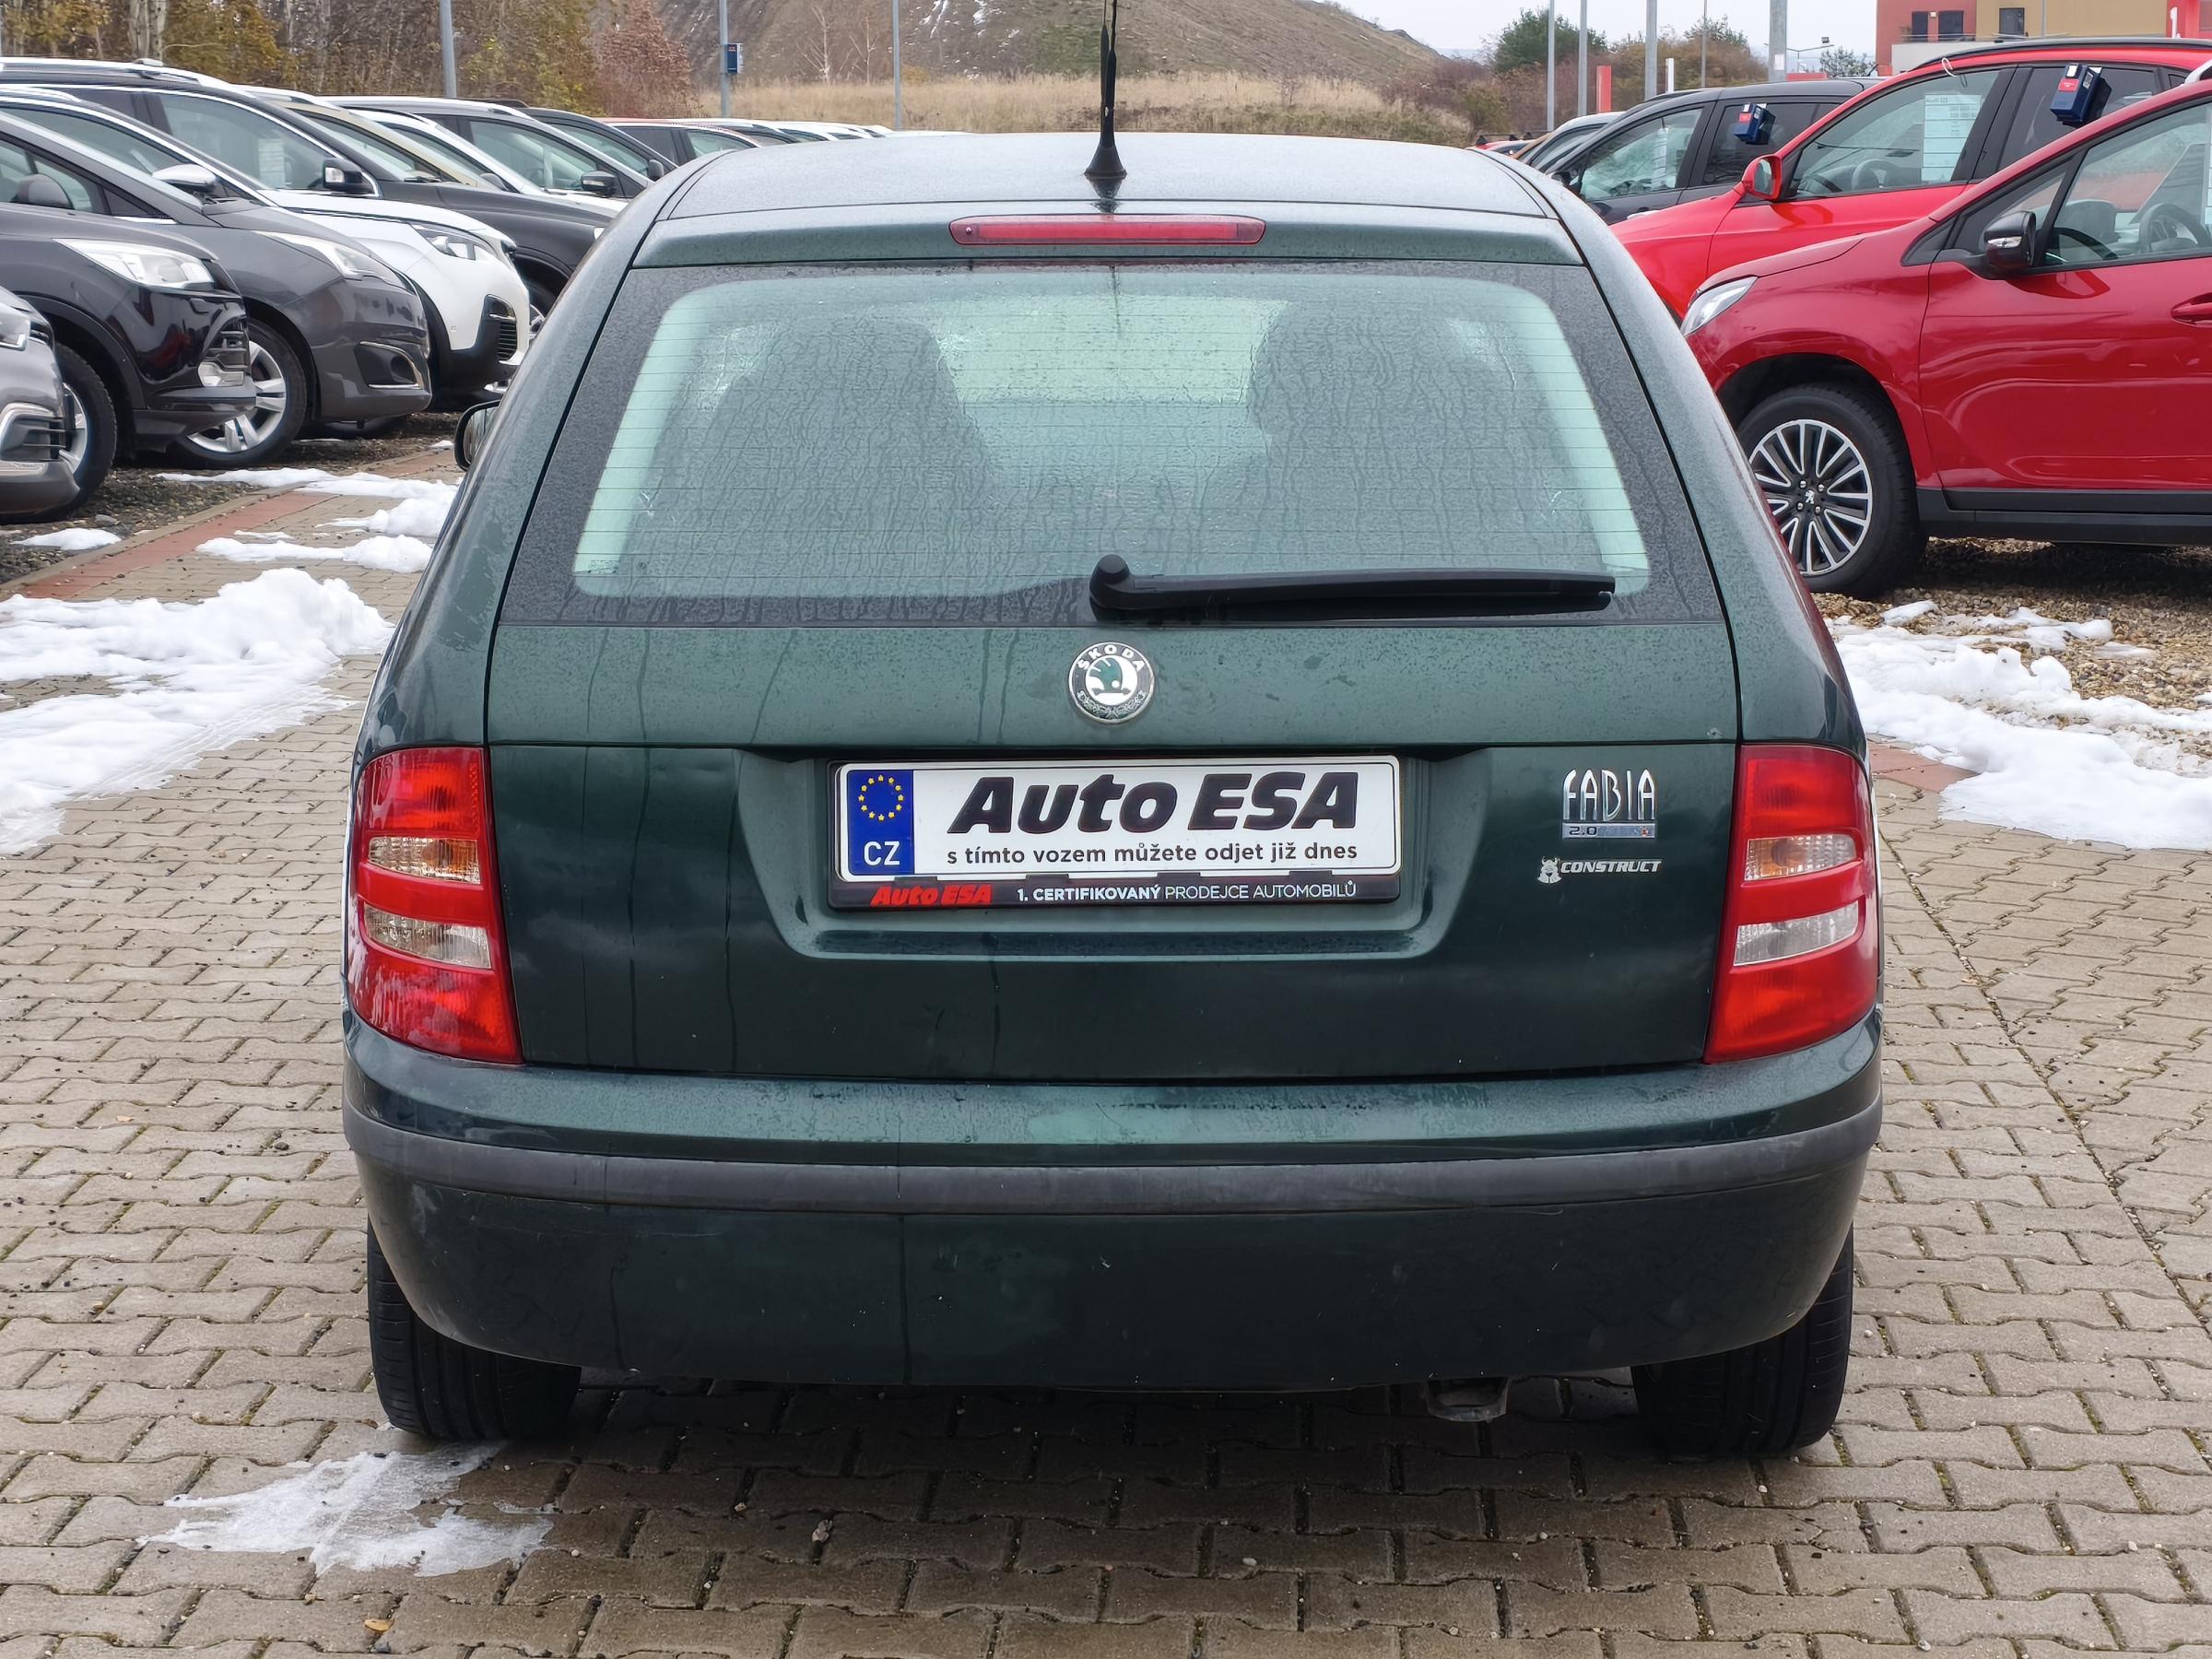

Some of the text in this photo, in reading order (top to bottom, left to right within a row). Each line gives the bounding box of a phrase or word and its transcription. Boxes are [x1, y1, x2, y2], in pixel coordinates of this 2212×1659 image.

[947, 771, 1359, 834] Auto ESA
[1562, 769, 1655, 822] FABIA
[1569, 826, 1598, 836] 2.0
[863, 841, 900, 866] CZ
[947, 841, 1358, 865] s tímto vozem můžete odjet již dnes
[1560, 860, 1662, 874] CONSTRUCT
[870, 884, 993, 907] Auto ESA
[1017, 880, 1357, 902] 1. CERTIFIKOVANÝ PRODEJCE AUTOMOBILŮ
